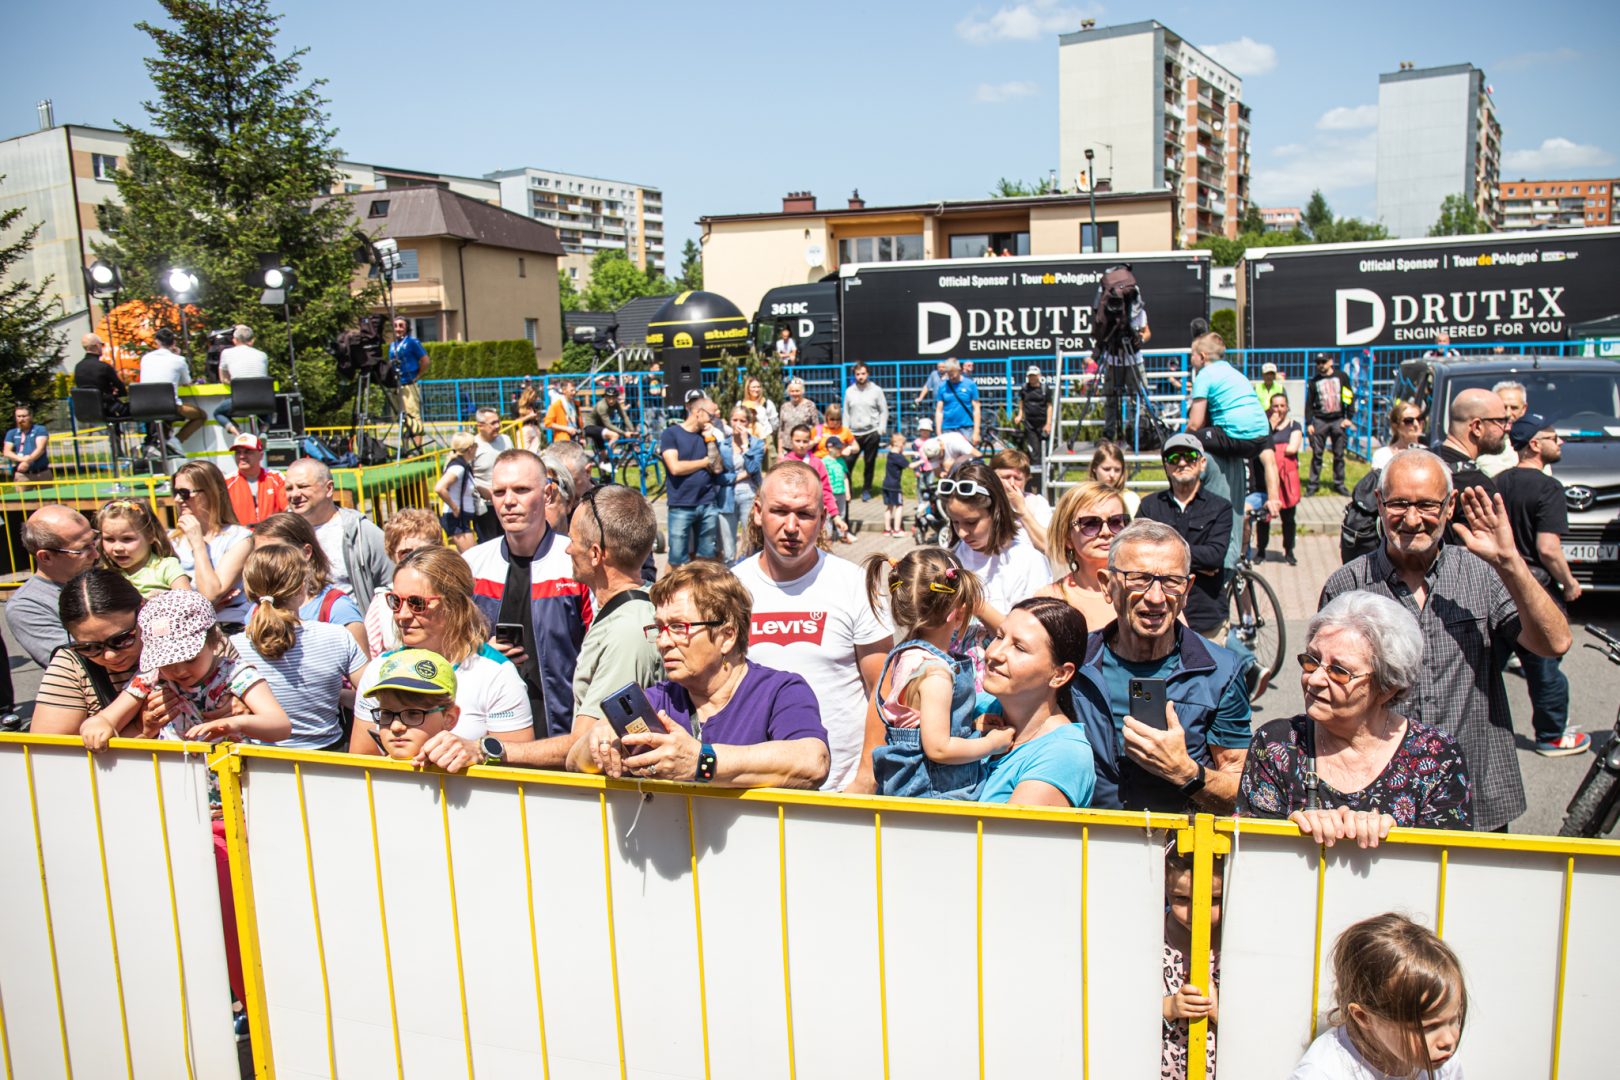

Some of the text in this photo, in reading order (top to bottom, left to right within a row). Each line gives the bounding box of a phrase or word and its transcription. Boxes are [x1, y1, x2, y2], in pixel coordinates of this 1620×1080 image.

[1360, 257, 1439, 272] Official Sponsor
[939, 275, 1009, 288] Official Sponsor
[771, 302, 808, 315] 3618C
[1391, 287, 1566, 326] DRUTEX
[966, 306, 1093, 337] DRUTE
[1394, 320, 1563, 341] ENGINEERED FOR YOU
[969, 337, 1051, 351] ENGINEERED
[1058, 337, 1083, 350] FOR
[1570, 546, 1615, 559] 410CV
